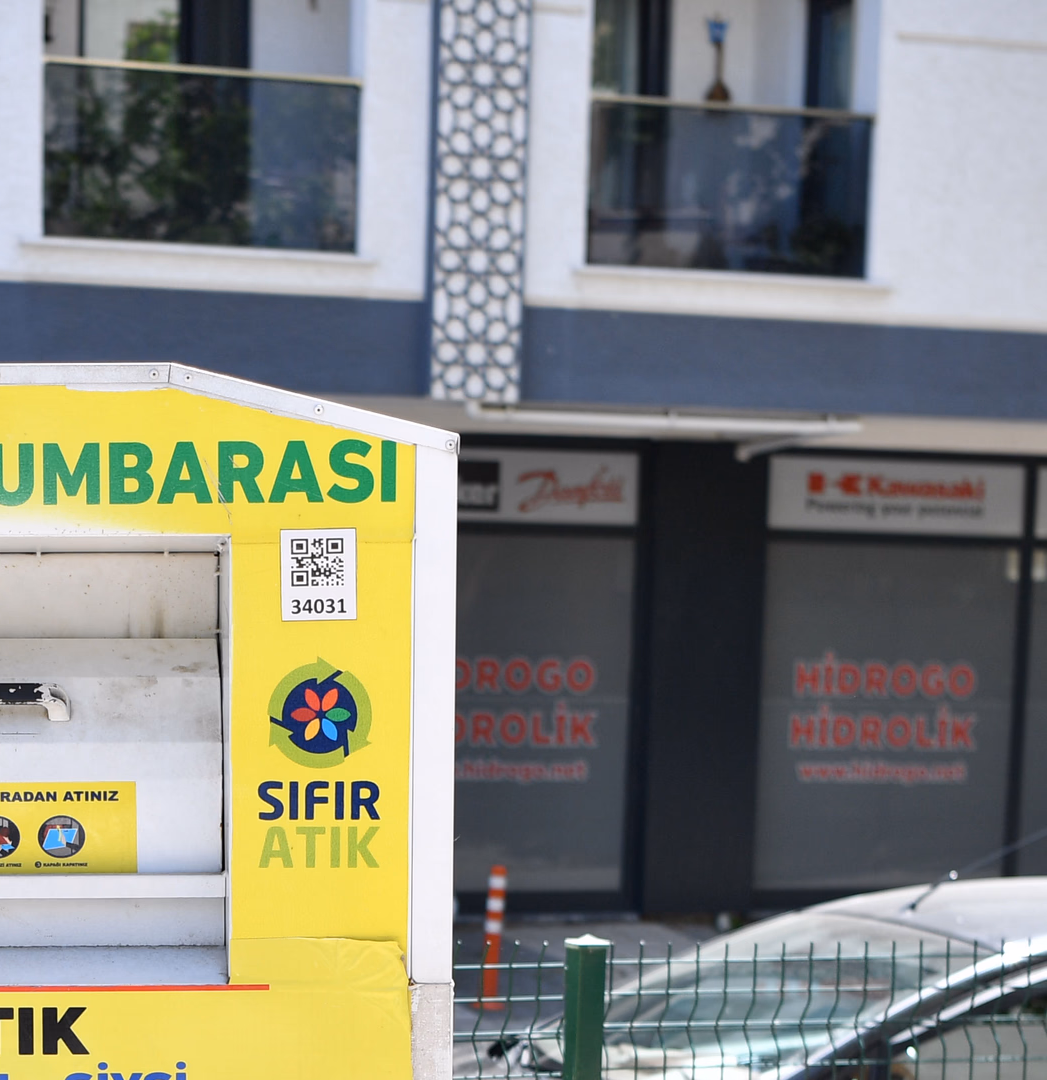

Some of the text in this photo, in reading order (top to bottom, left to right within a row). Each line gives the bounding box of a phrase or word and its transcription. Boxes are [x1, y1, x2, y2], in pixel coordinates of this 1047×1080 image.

[291, 598, 348, 615] 34031
[795, 651, 976, 697] HİDROGO
[789, 703, 975, 749] HİDROLİK
[62, 790, 119, 802] ATINIZ
[258, 780, 381, 821] SIFIR
[258, 826, 381, 868] ATIK
